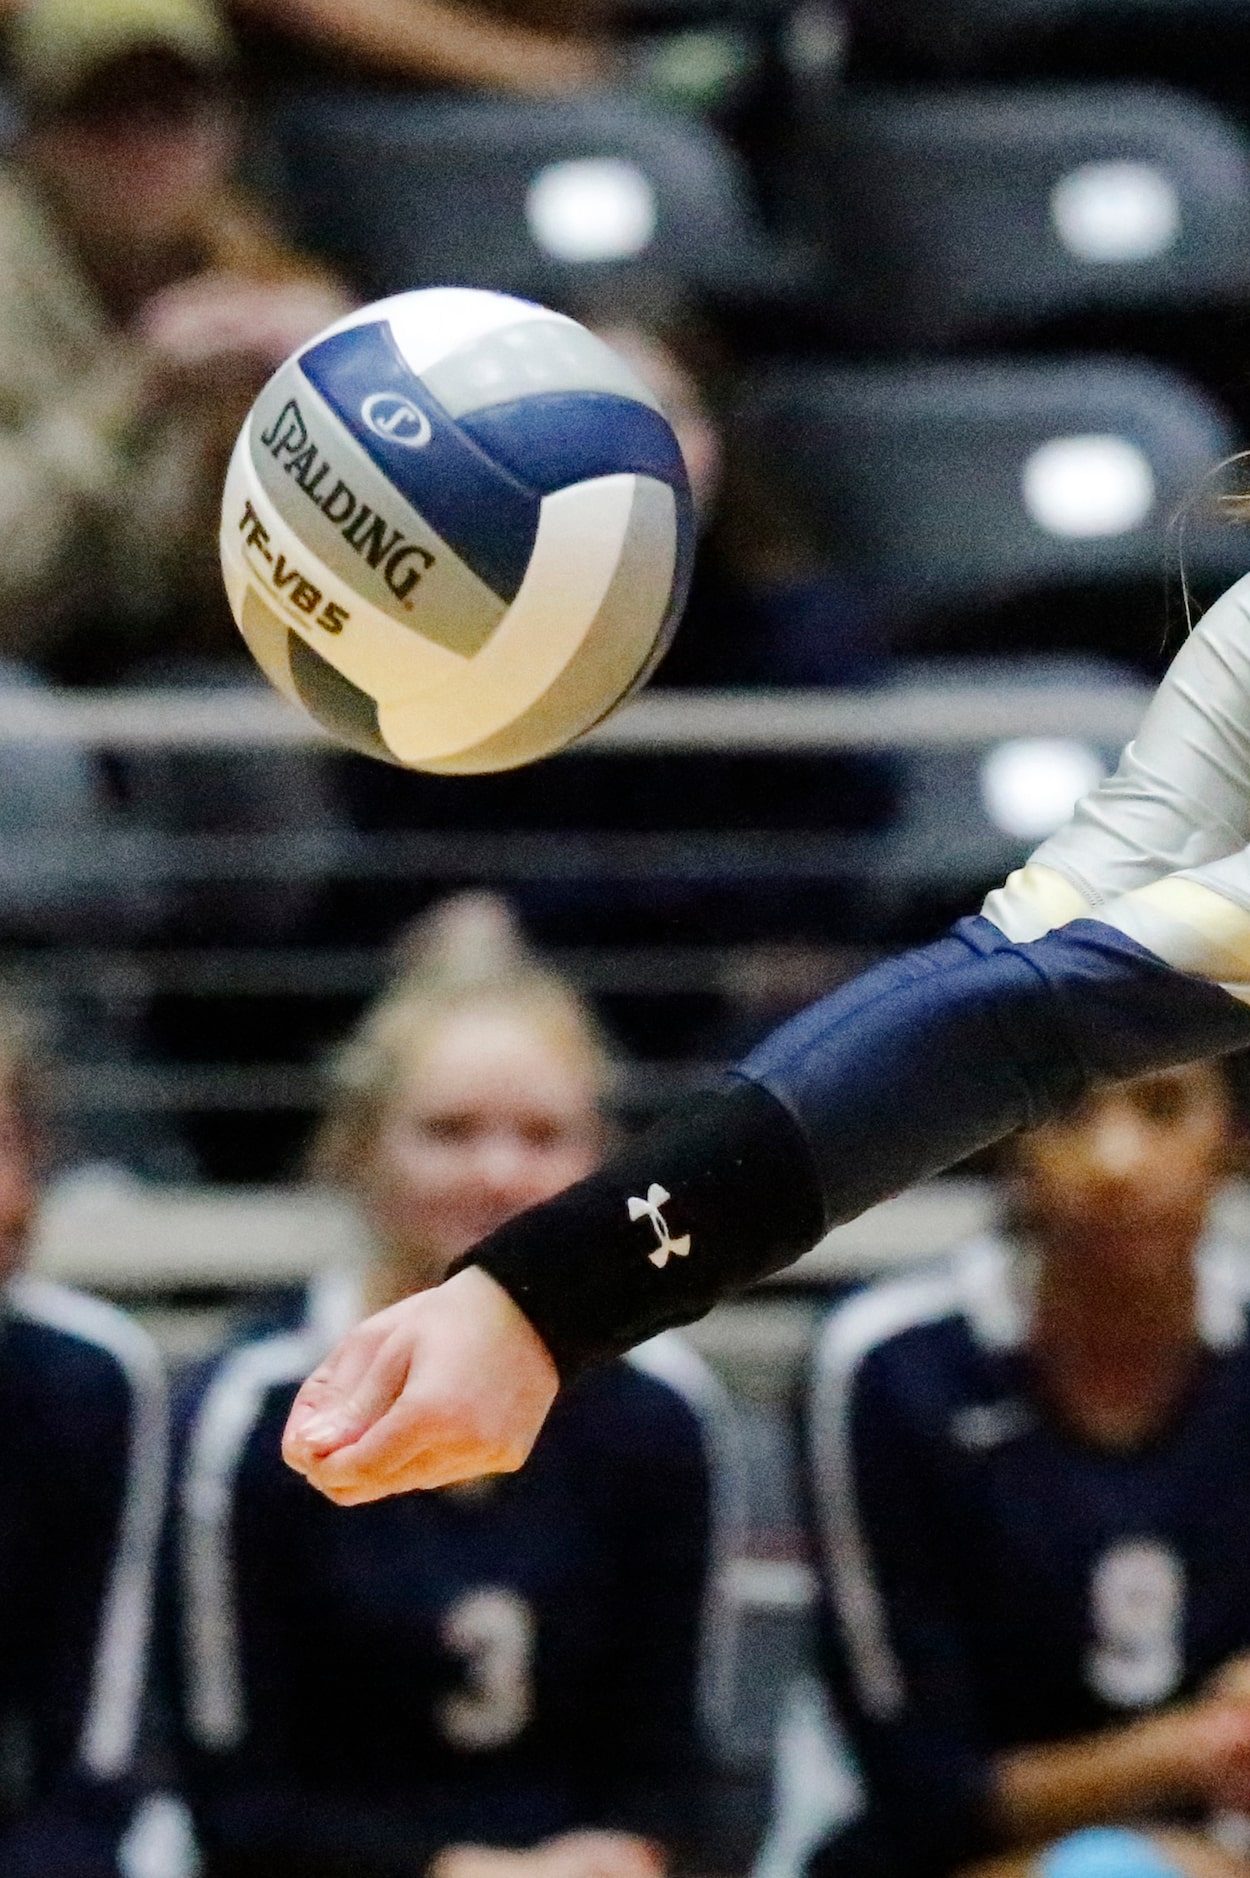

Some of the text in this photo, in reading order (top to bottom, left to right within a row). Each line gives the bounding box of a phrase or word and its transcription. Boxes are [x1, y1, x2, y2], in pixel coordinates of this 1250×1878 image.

[238, 500, 351, 636] TF-VB5
[261, 398, 436, 600] SPALDING
[440, 1587, 535, 1749] 3
